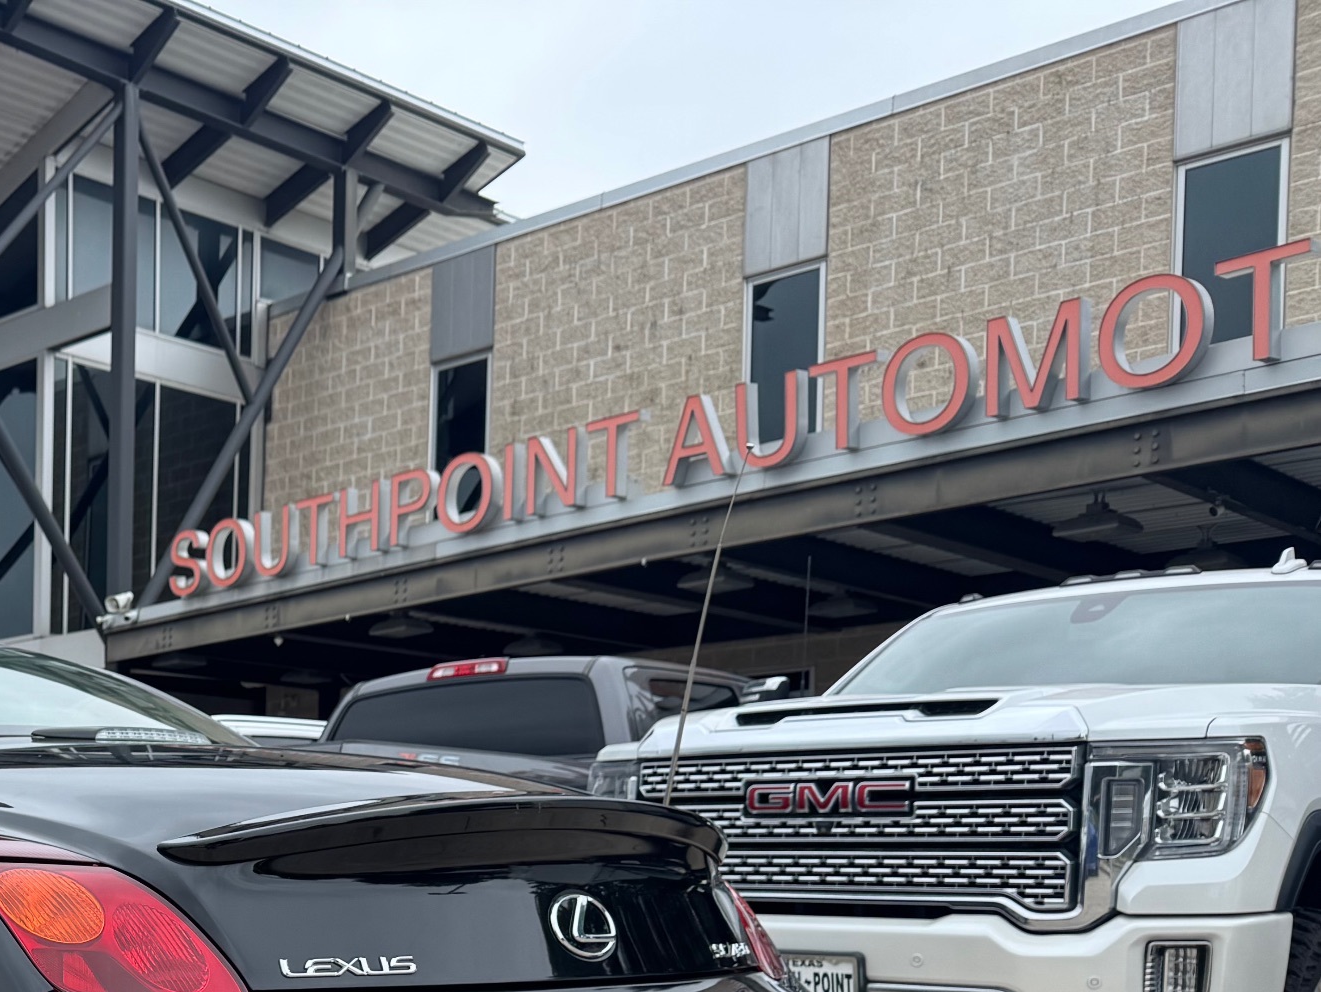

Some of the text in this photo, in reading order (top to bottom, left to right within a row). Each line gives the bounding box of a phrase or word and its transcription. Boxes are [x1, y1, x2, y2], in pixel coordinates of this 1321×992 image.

[168, 238, 1313, 597] SOUTHPOINT AUTOMOT
[746, 781, 911, 813] GMC
[279, 955, 417, 978] LEXUS
[790, 960, 824, 968] EXAS
